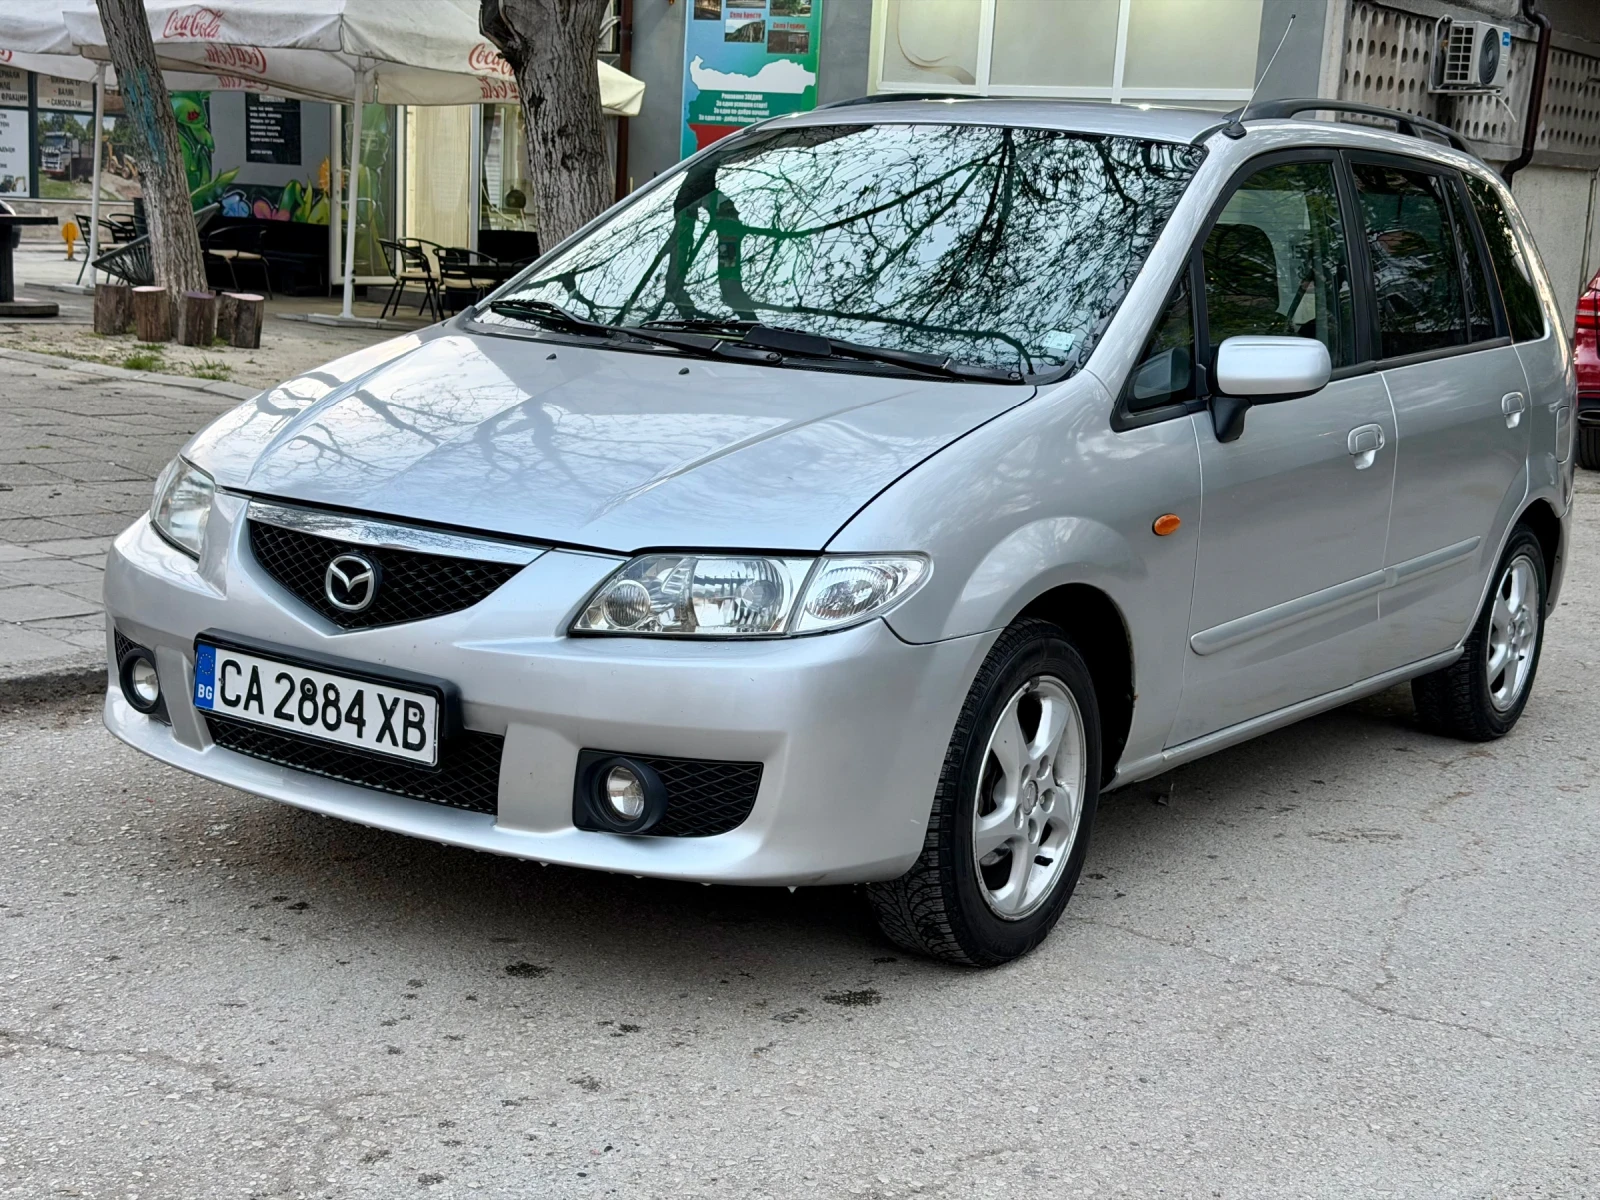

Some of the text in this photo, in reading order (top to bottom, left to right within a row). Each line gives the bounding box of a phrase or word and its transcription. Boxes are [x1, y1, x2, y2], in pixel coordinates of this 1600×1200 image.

[163, 8, 224, 38] Coca-Cola
[197, 684, 214, 700] BG
[220, 659, 427, 752] CA 2884 XB
